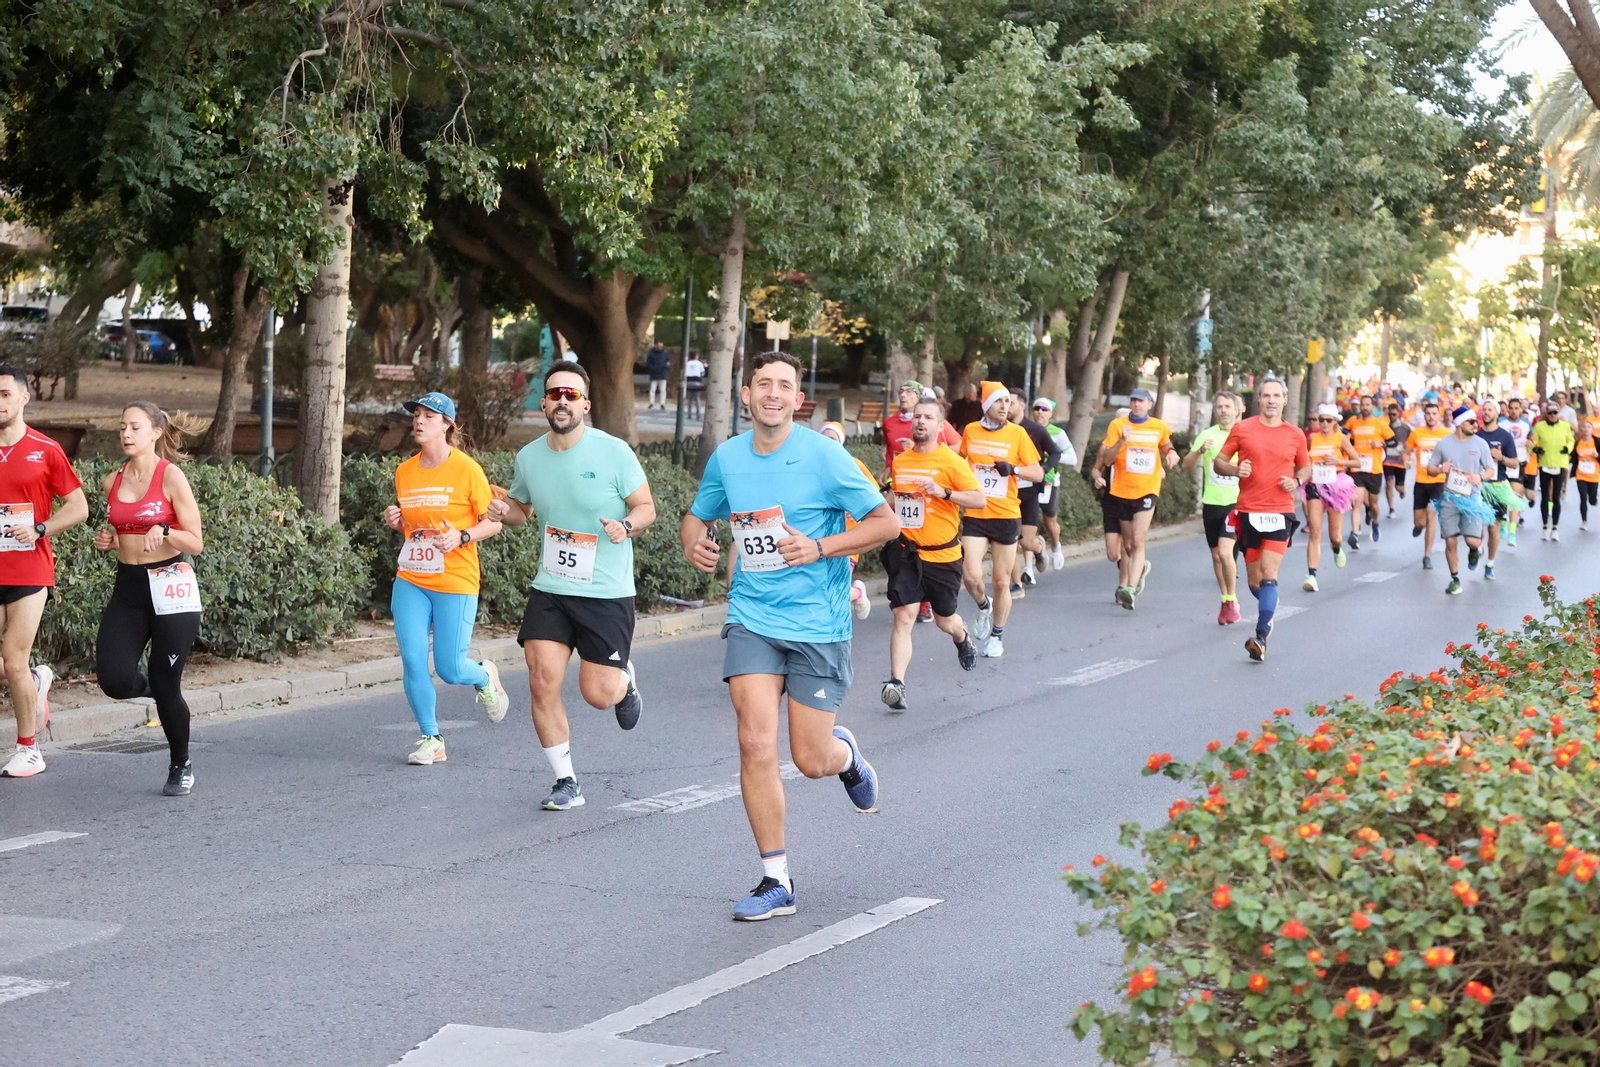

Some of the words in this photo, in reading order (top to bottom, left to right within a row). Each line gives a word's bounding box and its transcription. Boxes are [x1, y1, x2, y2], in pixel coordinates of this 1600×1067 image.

[1133, 457, 1150, 467] 486
[983, 478, 998, 489] 97
[1453, 478, 1468, 487] 837
[901, 506, 919, 518] 414
[1258, 515, 1278, 525] 190
[743, 535, 777, 556] 633
[408, 547, 434, 562] 130
[557, 549, 577, 568] 55
[164, 583, 192, 599] 467
